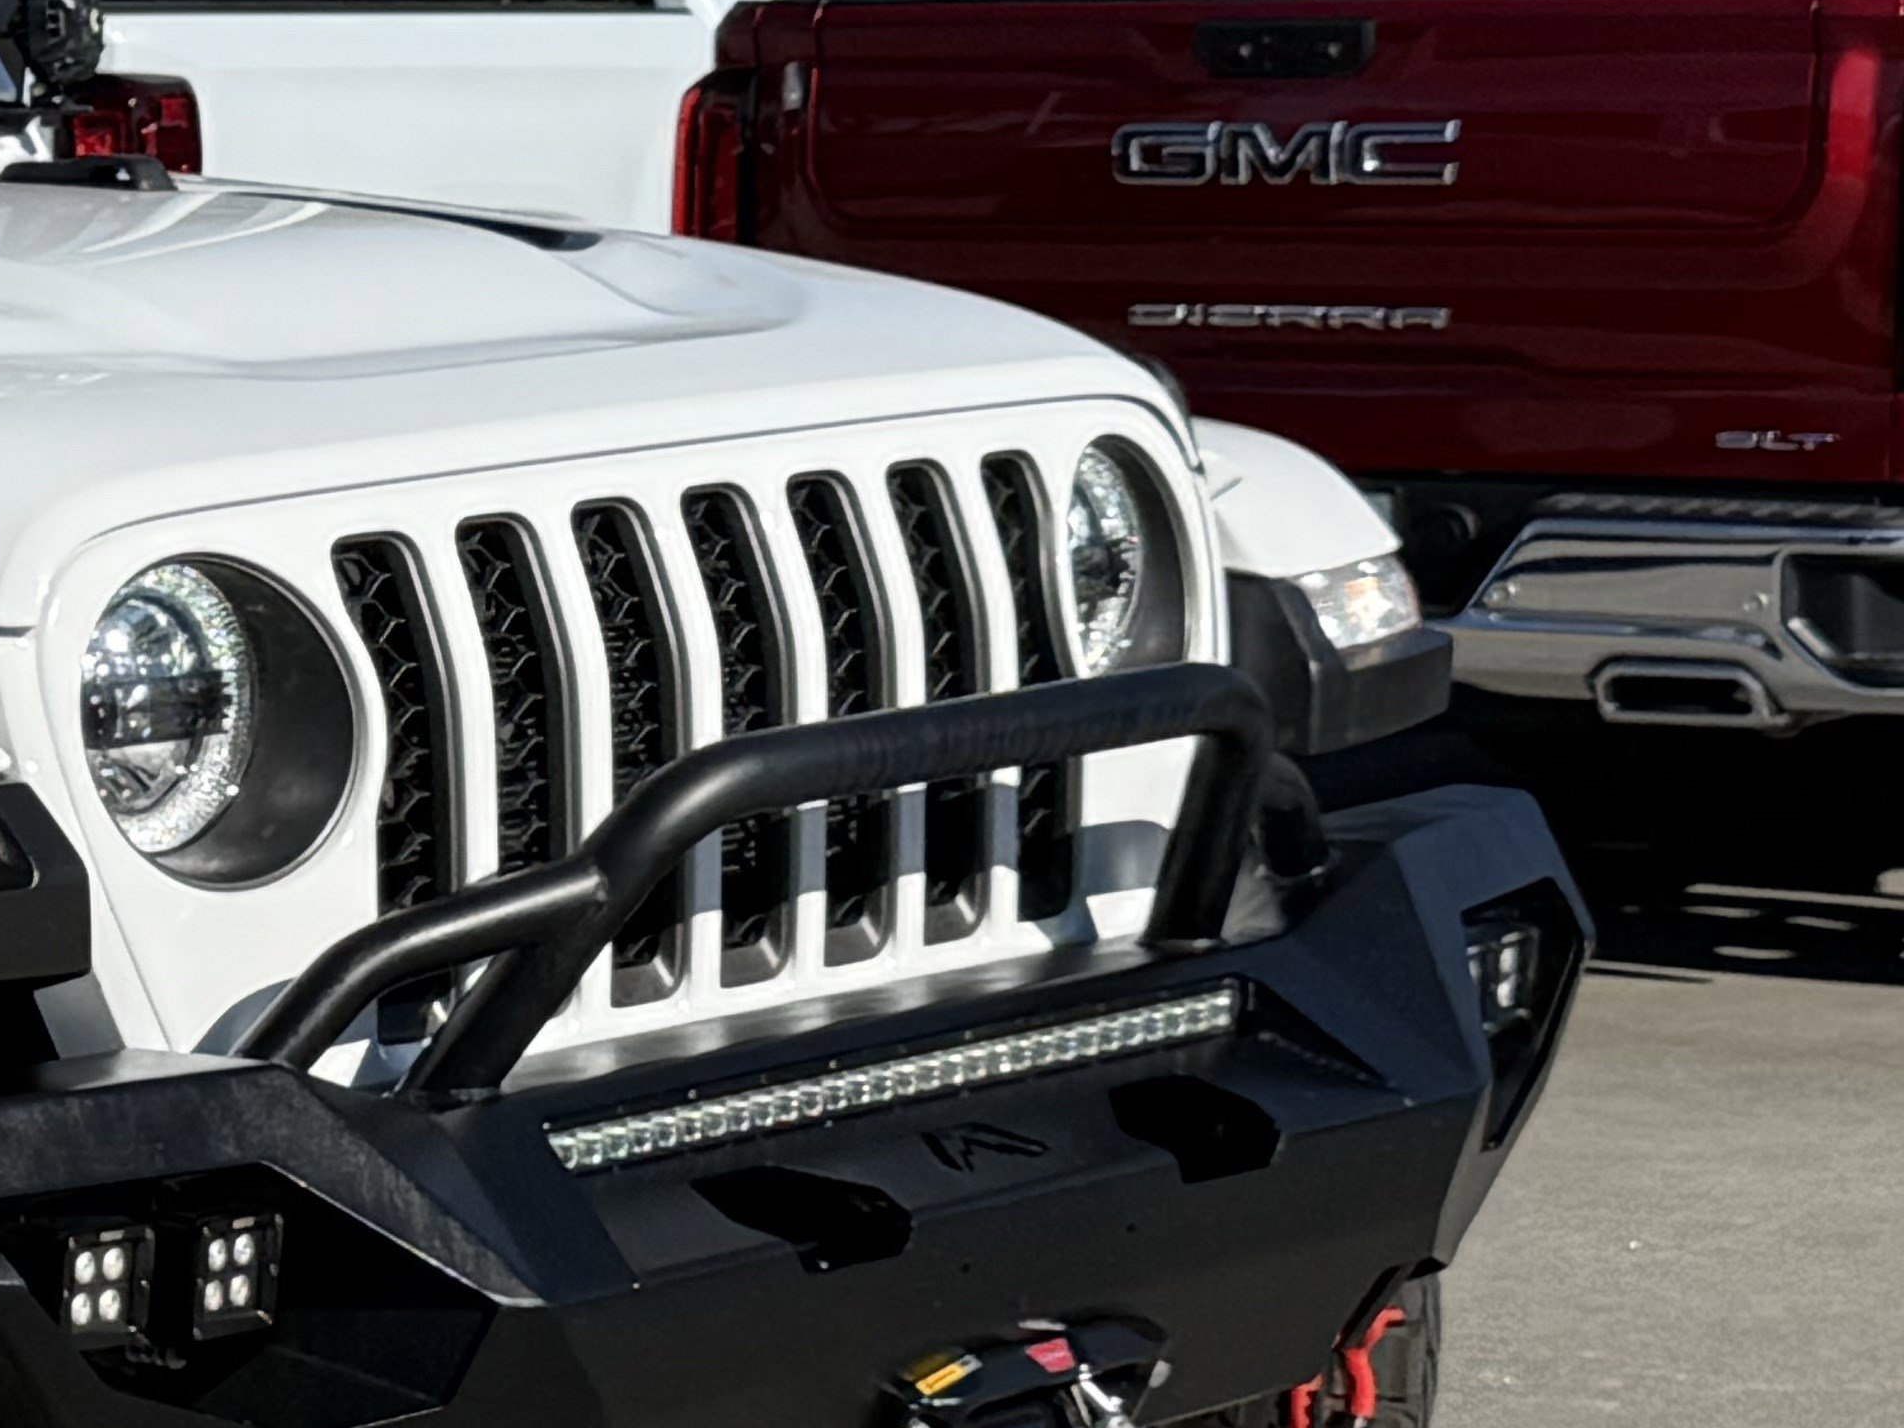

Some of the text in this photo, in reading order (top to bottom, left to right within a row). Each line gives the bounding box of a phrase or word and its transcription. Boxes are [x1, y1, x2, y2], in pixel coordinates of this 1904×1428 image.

[1111, 119, 1462, 186] GMC
[1127, 303, 1453, 330] SIERRA
[1714, 429, 1842, 452] SLT
